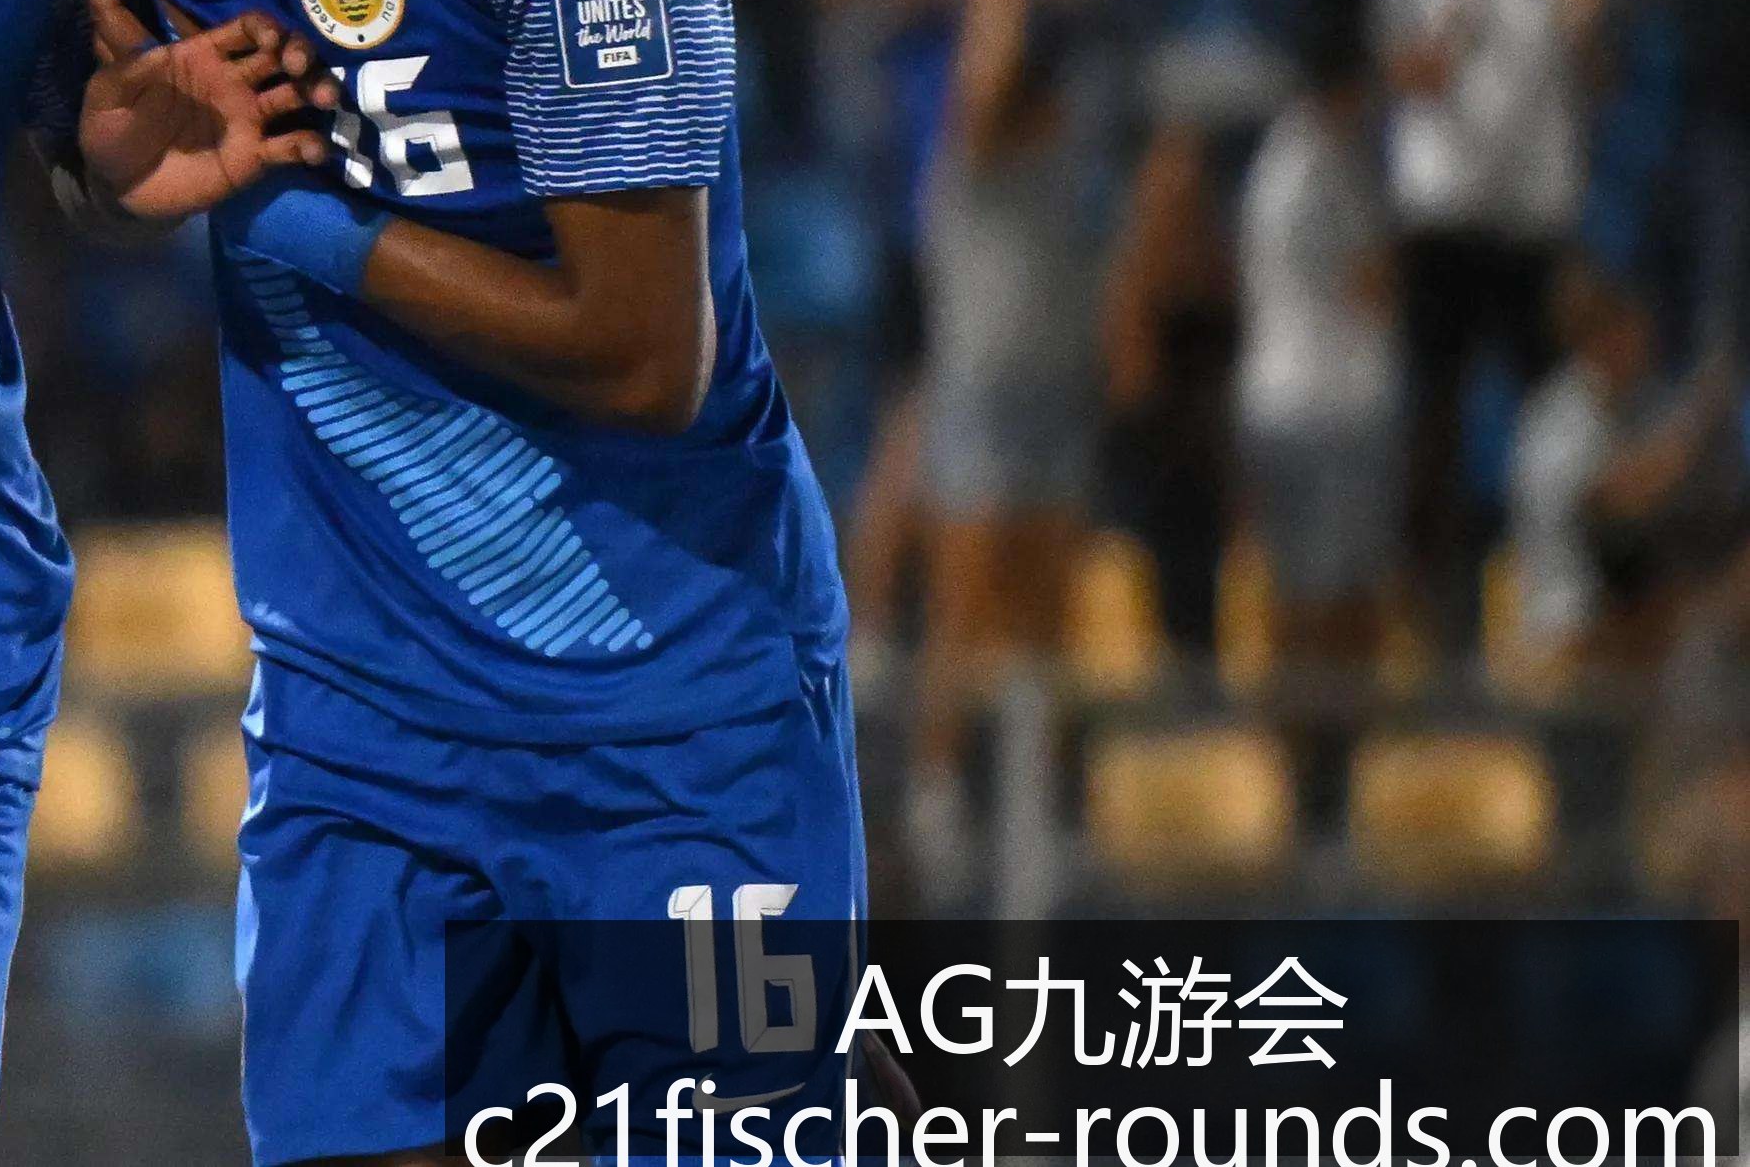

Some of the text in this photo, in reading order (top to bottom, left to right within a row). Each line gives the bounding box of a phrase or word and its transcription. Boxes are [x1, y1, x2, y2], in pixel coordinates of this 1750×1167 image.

[575, 18, 652, 47] the World
[603, 49, 632, 64] FIFA
[667, 883, 818, 1054] 16
